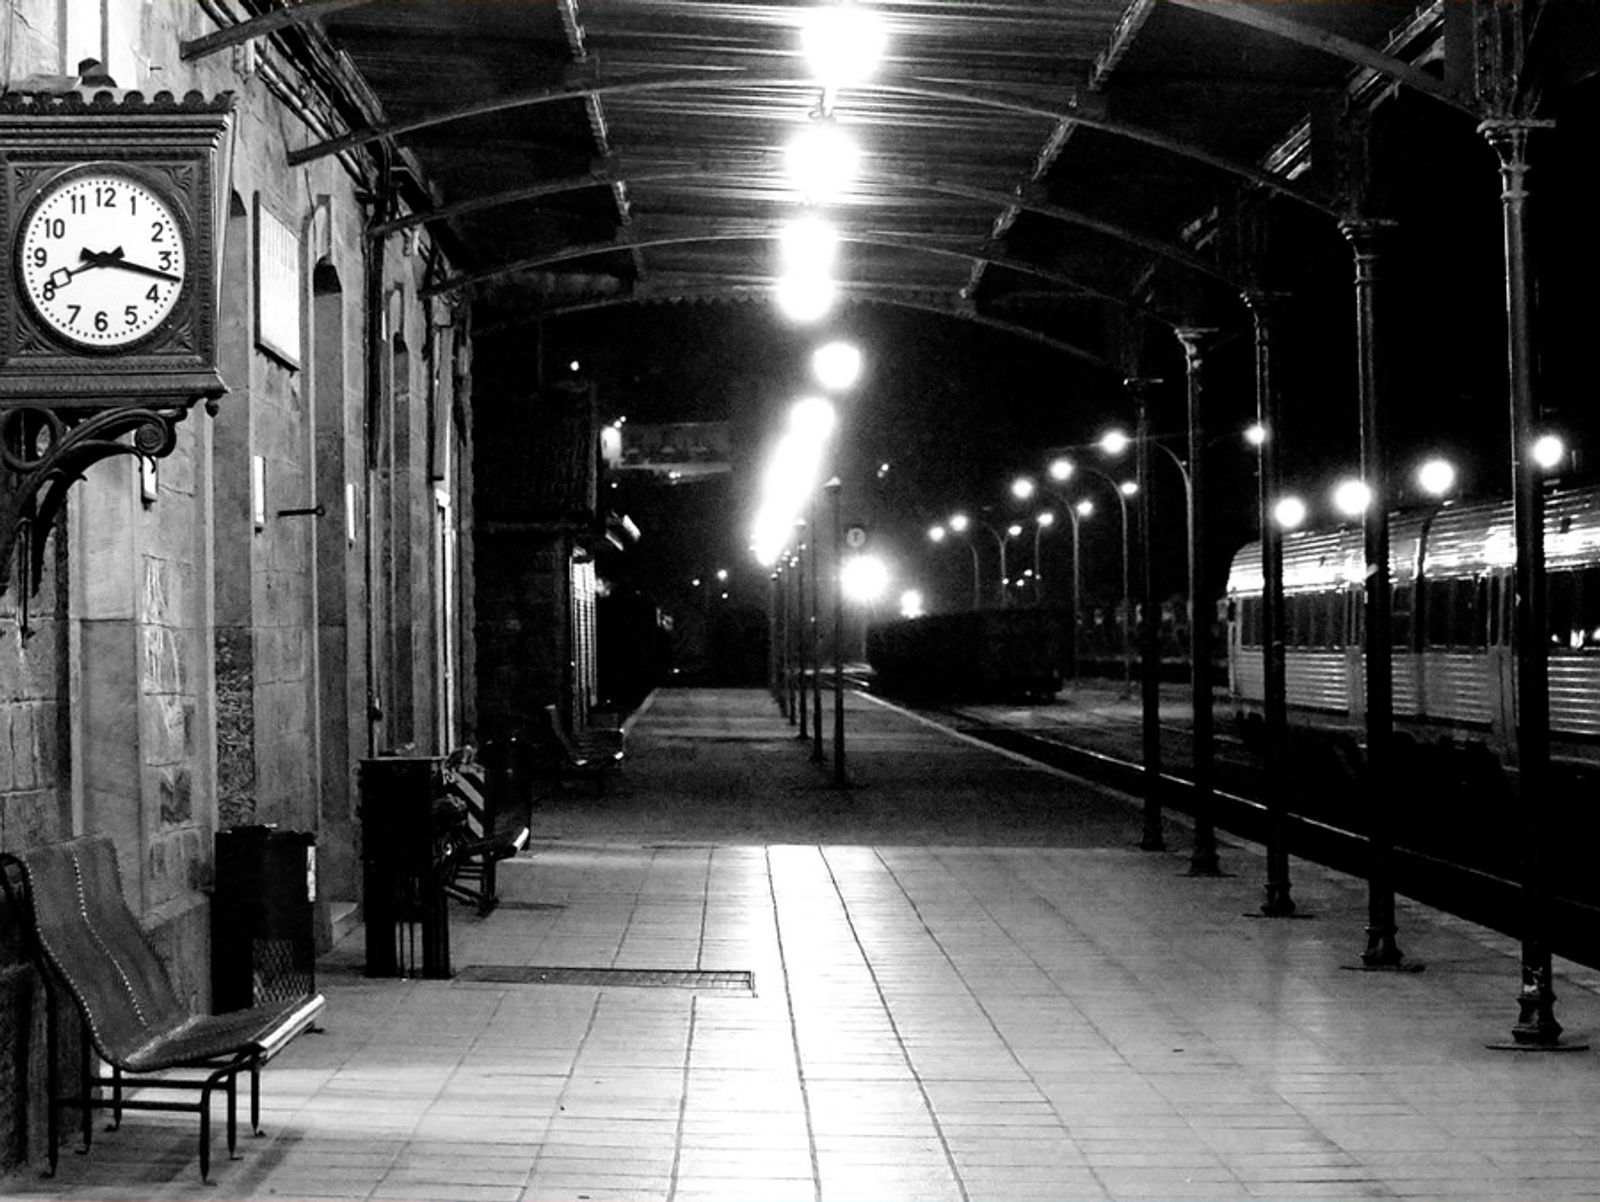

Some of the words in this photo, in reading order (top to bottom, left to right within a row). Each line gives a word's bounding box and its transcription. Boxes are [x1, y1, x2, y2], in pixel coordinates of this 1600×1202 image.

[70, 194, 86, 215] 11
[95, 187, 117, 208] 12
[130, 195, 136, 216] 1
[44, 218, 66, 239] 10
[151, 222, 164, 243] 2
[34, 247, 48, 268] 9
[158, 250, 172, 272] 3
[43, 280, 55, 301] 8
[145, 283, 160, 304] 4
[67, 304, 82, 325] 7
[94, 311, 109, 332] 6
[124, 305, 138, 326] 5
